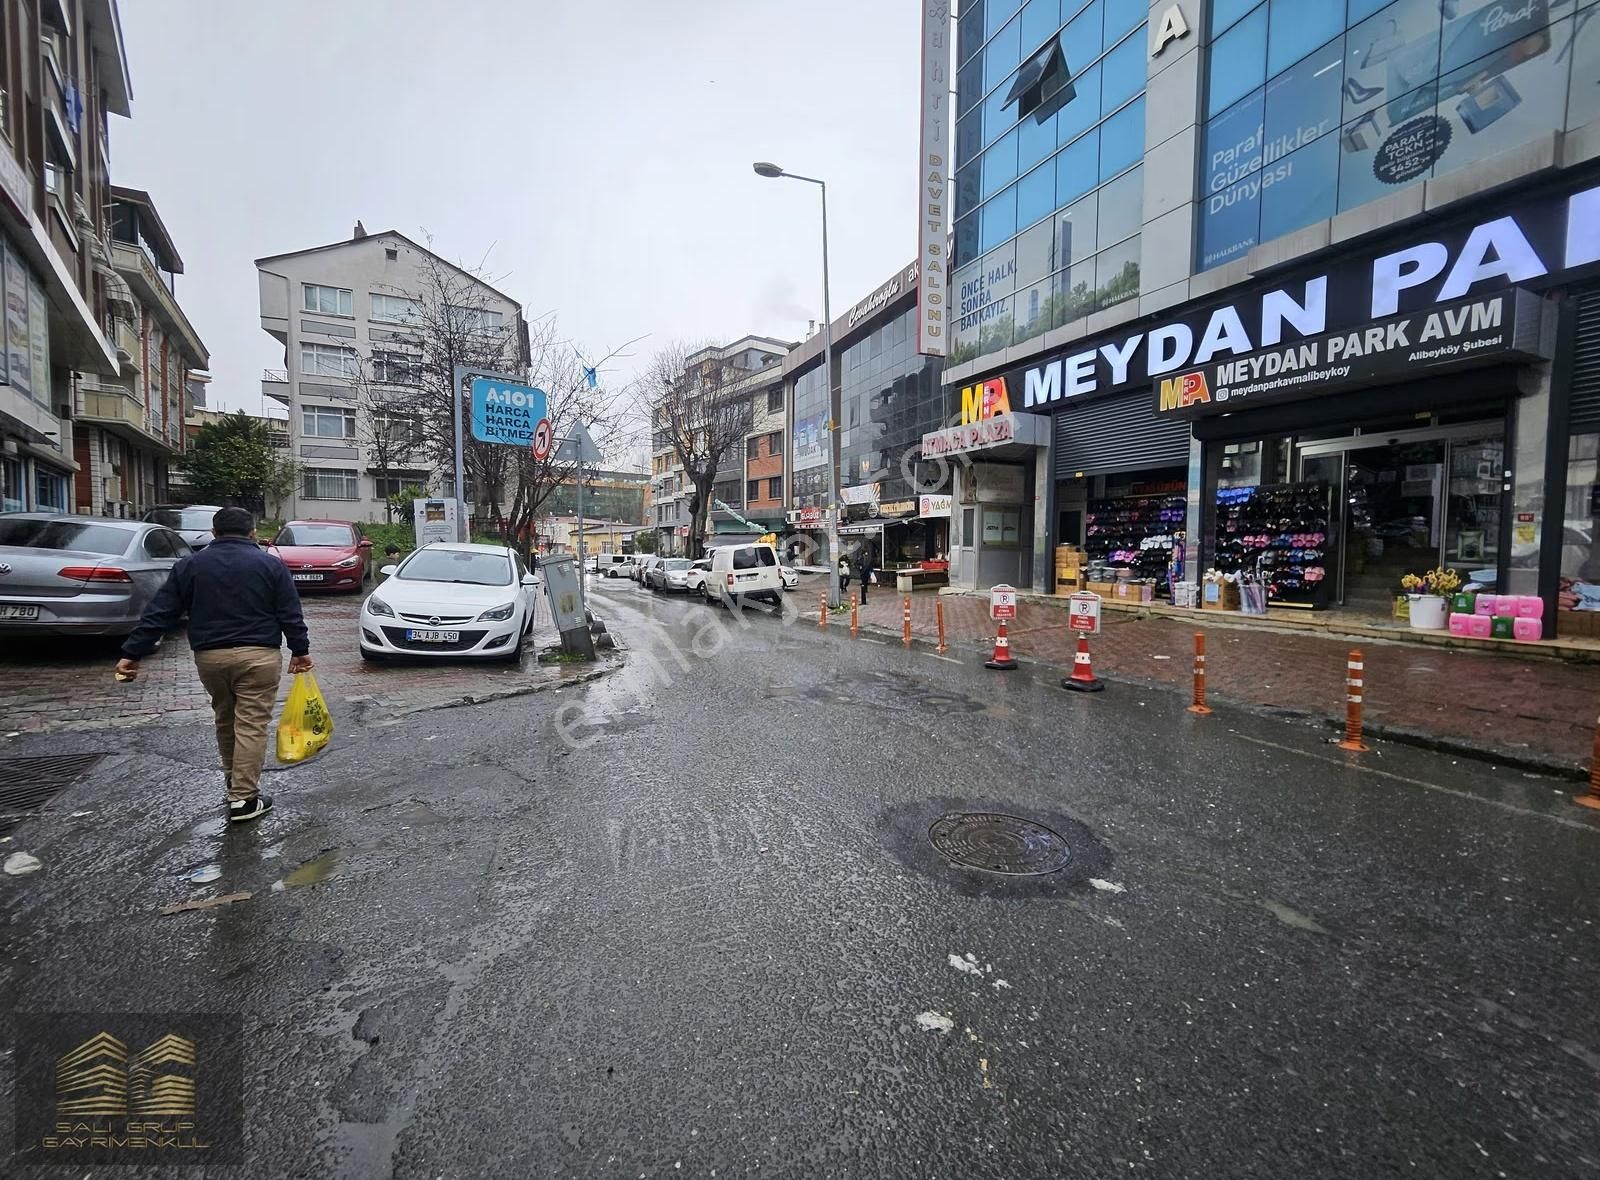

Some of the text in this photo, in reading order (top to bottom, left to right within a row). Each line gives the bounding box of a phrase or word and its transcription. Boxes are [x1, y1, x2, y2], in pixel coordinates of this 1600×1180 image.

[1151, 4, 1191, 57] A
[1211, 119, 1329, 193] Güzellikler
[1212, 123, 1265, 171] Paraf
[1385, 129, 1425, 154] PARAF
[928, 154, 942, 233] DAVET
[1210, 162, 1292, 215] Dünyası
[1212, 238, 1255, 261] HALKBANK
[927, 243, 942, 338] SALONU
[961, 274, 986, 300] ÖNCE
[960, 289, 992, 316] SONRA
[1024, 275, 1328, 408] MEYDAN
[1216, 297, 1503, 387] MEYDAN PARK AVM
[1408, 334, 1503, 363] Alibeyköy Şubesi
[1230, 365, 1351, 397] meydanparkavmalibeykoy
[485, 403, 531, 419] HARCA
[485, 414, 531, 430] HARCA
[970, 419, 1012, 447] PLAZA
[11, 606, 35, 616] 780
[411, 631, 458, 641] 34 AJB 450
